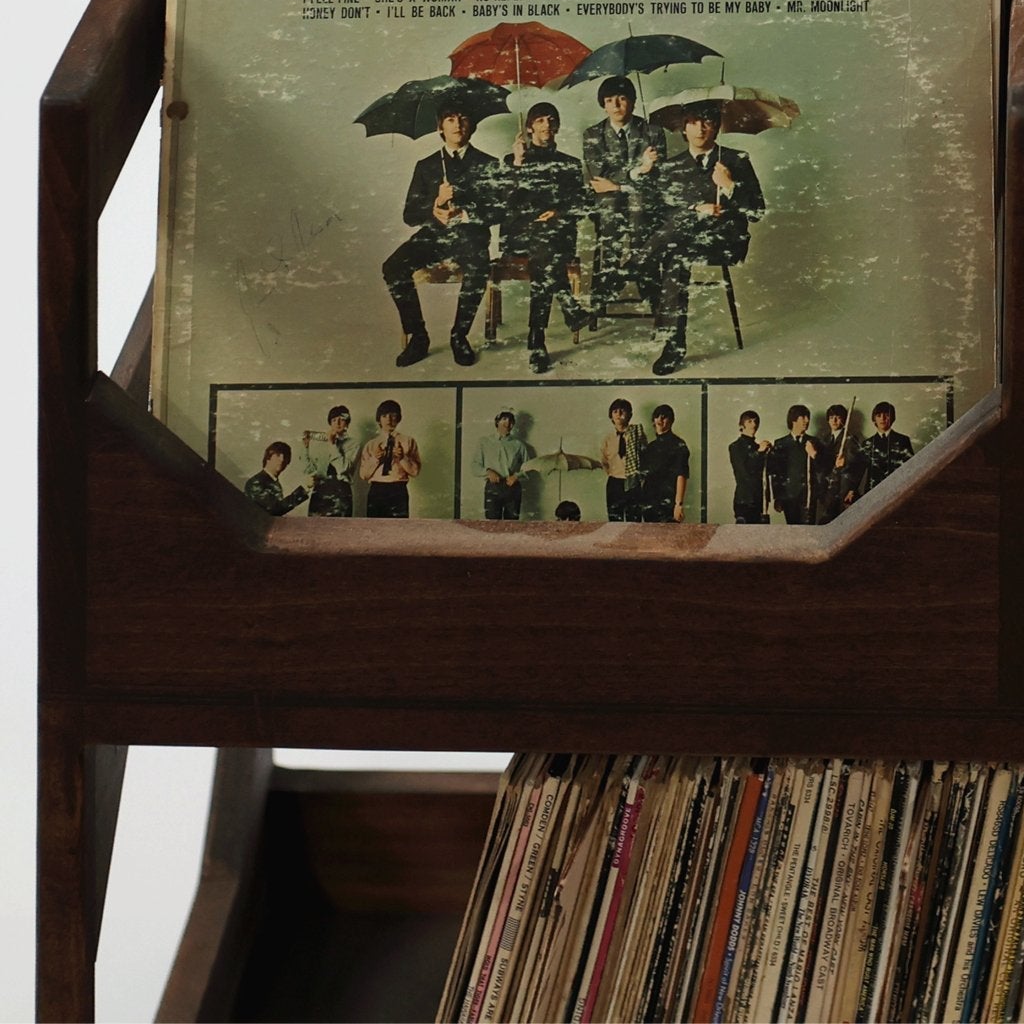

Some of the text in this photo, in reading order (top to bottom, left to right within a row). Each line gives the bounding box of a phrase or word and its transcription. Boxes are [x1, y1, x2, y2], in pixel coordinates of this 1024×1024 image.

[341, 6, 371, 19] DON'T
[387, 6, 405, 18] I'LL
[411, 6, 425, 18] BE
[429, 5, 456, 18] BACK
[473, 5, 508, 17] BABY'S
[513, 4, 523, 16] IN
[528, 4, 560, 16] BLACK
[577, 2, 644, 16] EVERYBODY'S
[651, 3, 687, 14] TRYING
[691, 2, 704, 14] TO
[709, 2, 721, 13] BE
[725, 1, 741, 13] MY
[745, 1, 771, 13] BABY
[811, 0, 870, 13] MOONLIGHT
[537, 794, 554, 832] COMDEN
[525, 842, 542, 874] GREEN
[515, 883, 530, 912] STYNE
[815, 803, 855, 991] TOVARICH ORIGINAL BROADWAY CAST
[727, 889, 747, 951] JOHNNY DODDS
[954, 840, 999, 1011] DELICADO LEW DAVIES and his Orchestra
[490, 957, 509, 1000] SUBWAYS
[484, 1002, 499, 1020] ARE
